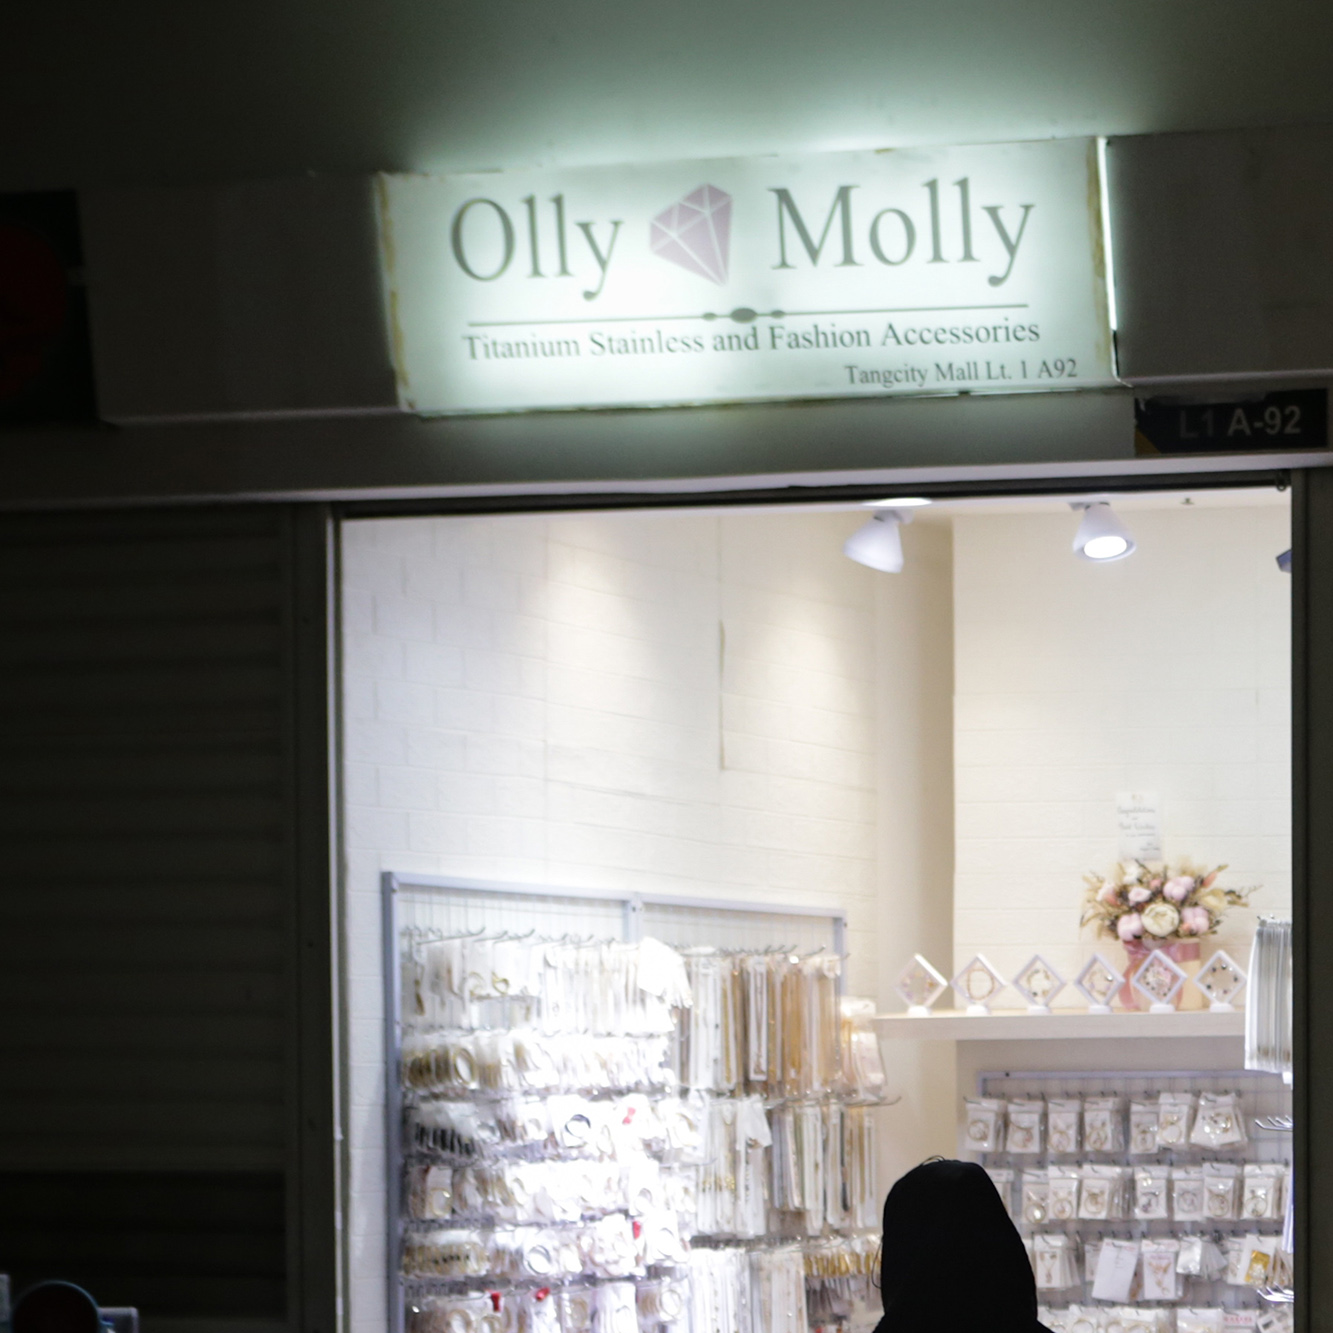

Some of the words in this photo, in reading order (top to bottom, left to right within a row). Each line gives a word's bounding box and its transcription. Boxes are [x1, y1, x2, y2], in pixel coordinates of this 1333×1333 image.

[450, 193, 624, 301] Olly
[768, 177, 1035, 287] Molly
[463, 332, 580, 360] Titanium
[590, 330, 704, 356] Stainless
[712, 327, 760, 352] and
[769, 324, 870, 350] Fashion
[882, 318, 1040, 346] Accessories
[844, 365, 928, 388] Tangcity
[935, 361, 978, 382] Mall
[986, 361, 1012, 380] Lt.
[1021, 360, 1027, 378] 1
[1038, 359, 1078, 378] A92
[1179, 408, 1214, 439] L1
[1227, 404, 1302, 437] A-92
